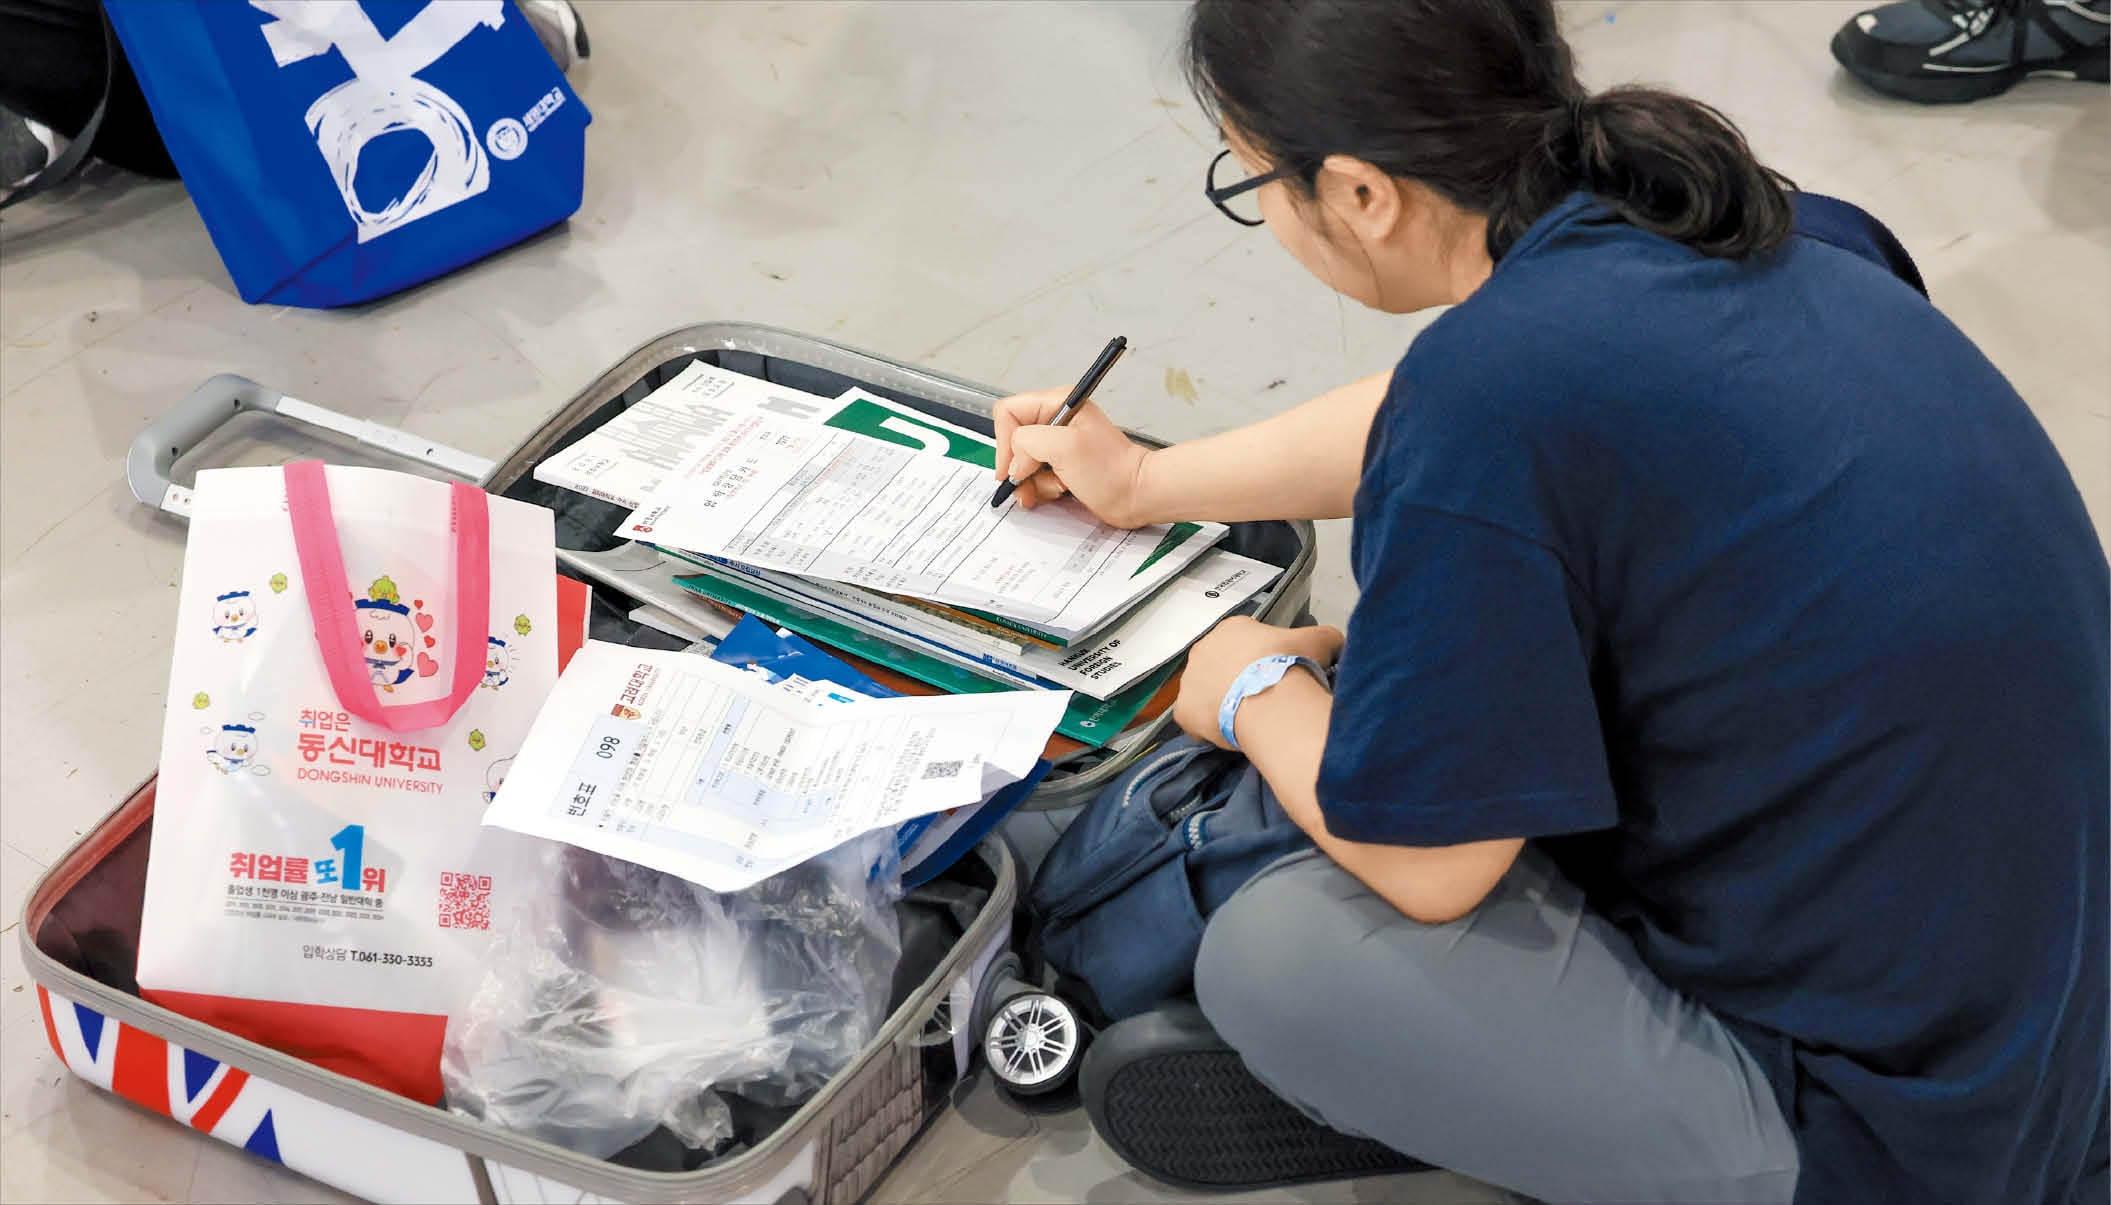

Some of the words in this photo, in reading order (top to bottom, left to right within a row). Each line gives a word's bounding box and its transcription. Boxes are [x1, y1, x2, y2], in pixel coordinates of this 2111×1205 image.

[1068, 646, 1111, 671] UNIVERSITY
[1109, 639, 1121, 648] OF
[1080, 656, 1113, 675] FOREIGN
[620, 663, 653, 705] 고려대학교
[1090, 661, 1122, 680] STUDIES
[299, 708, 351, 732] 취업은
[297, 732, 441, 773] 동신대학교
[297, 767, 371, 785] DONGSHIN
[375, 775, 443, 795] UNIVERSITY
[567, 782, 597, 817] 번호표
[596, 735, 620, 760] 098
[229, 851, 310, 885] 취업률
[281, 888, 298, 900] 이상
[302, 944, 347, 961] 입학상담
